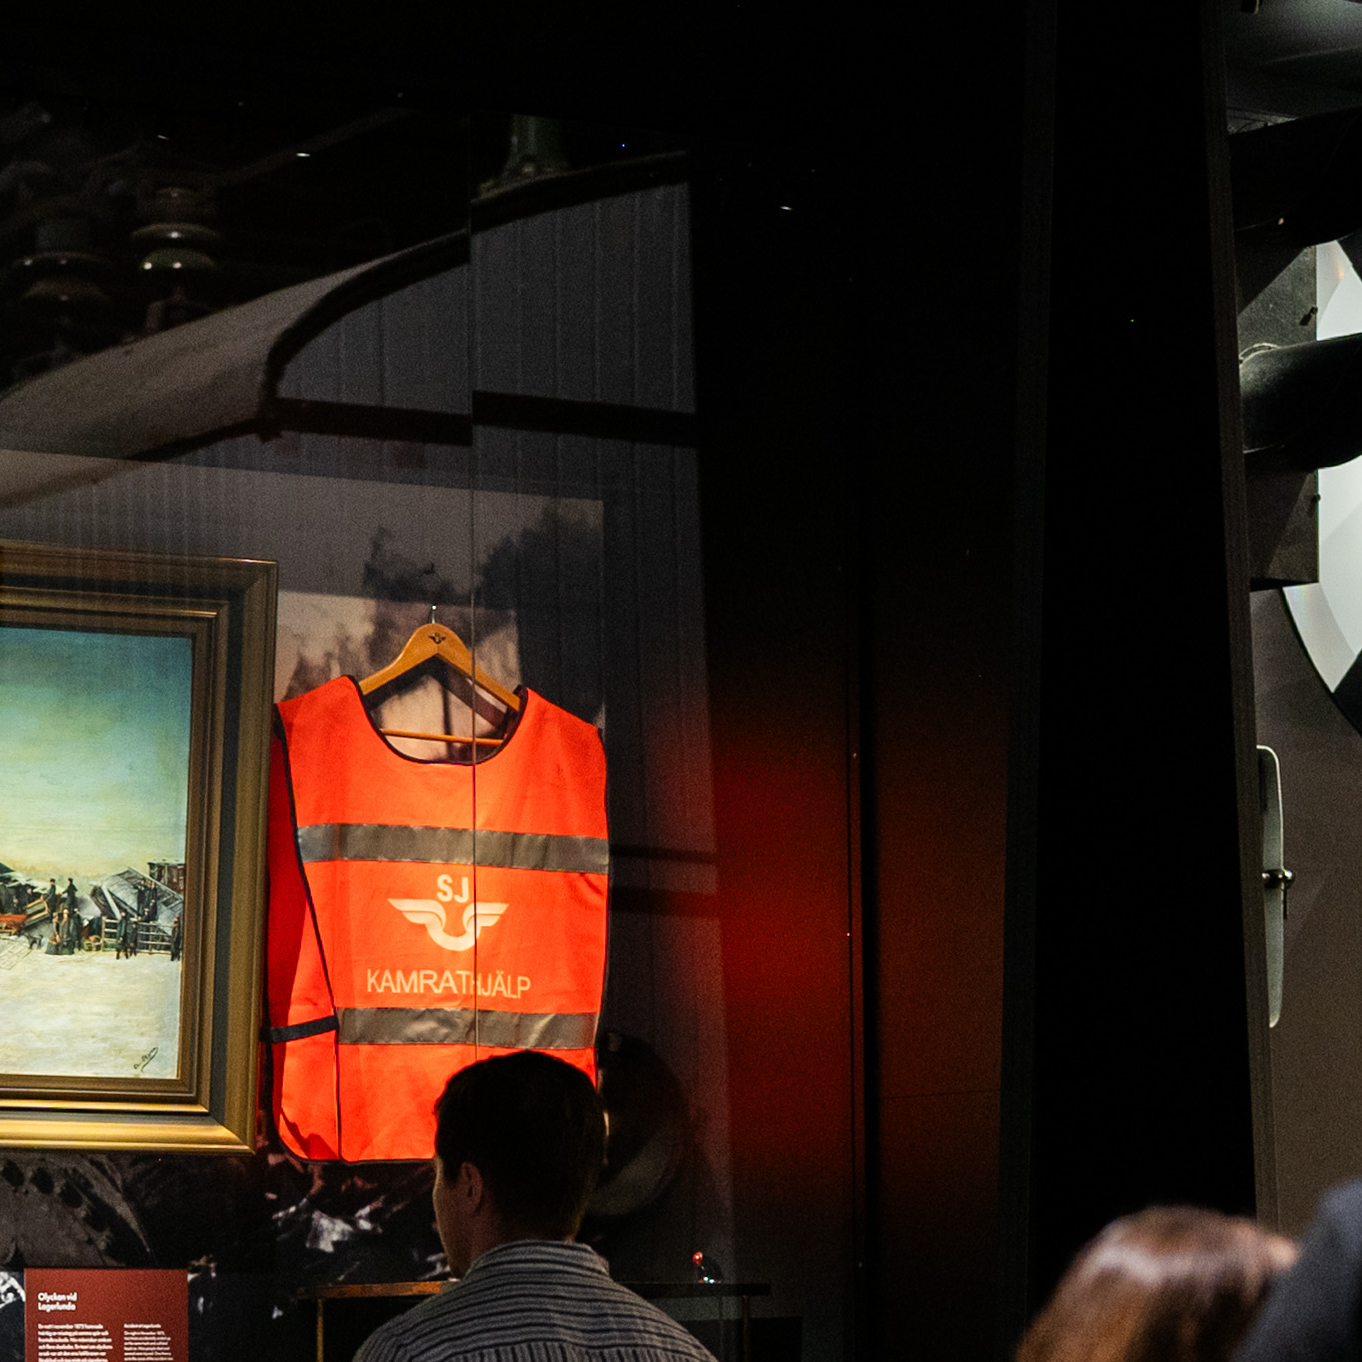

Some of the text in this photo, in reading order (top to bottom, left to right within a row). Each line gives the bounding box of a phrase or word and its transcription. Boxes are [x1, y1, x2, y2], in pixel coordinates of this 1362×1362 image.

[437, 874, 469, 903] SJ
[367, 969, 531, 999] KAMRATHJÄLP
[66, 1292, 77, 1301] vid
